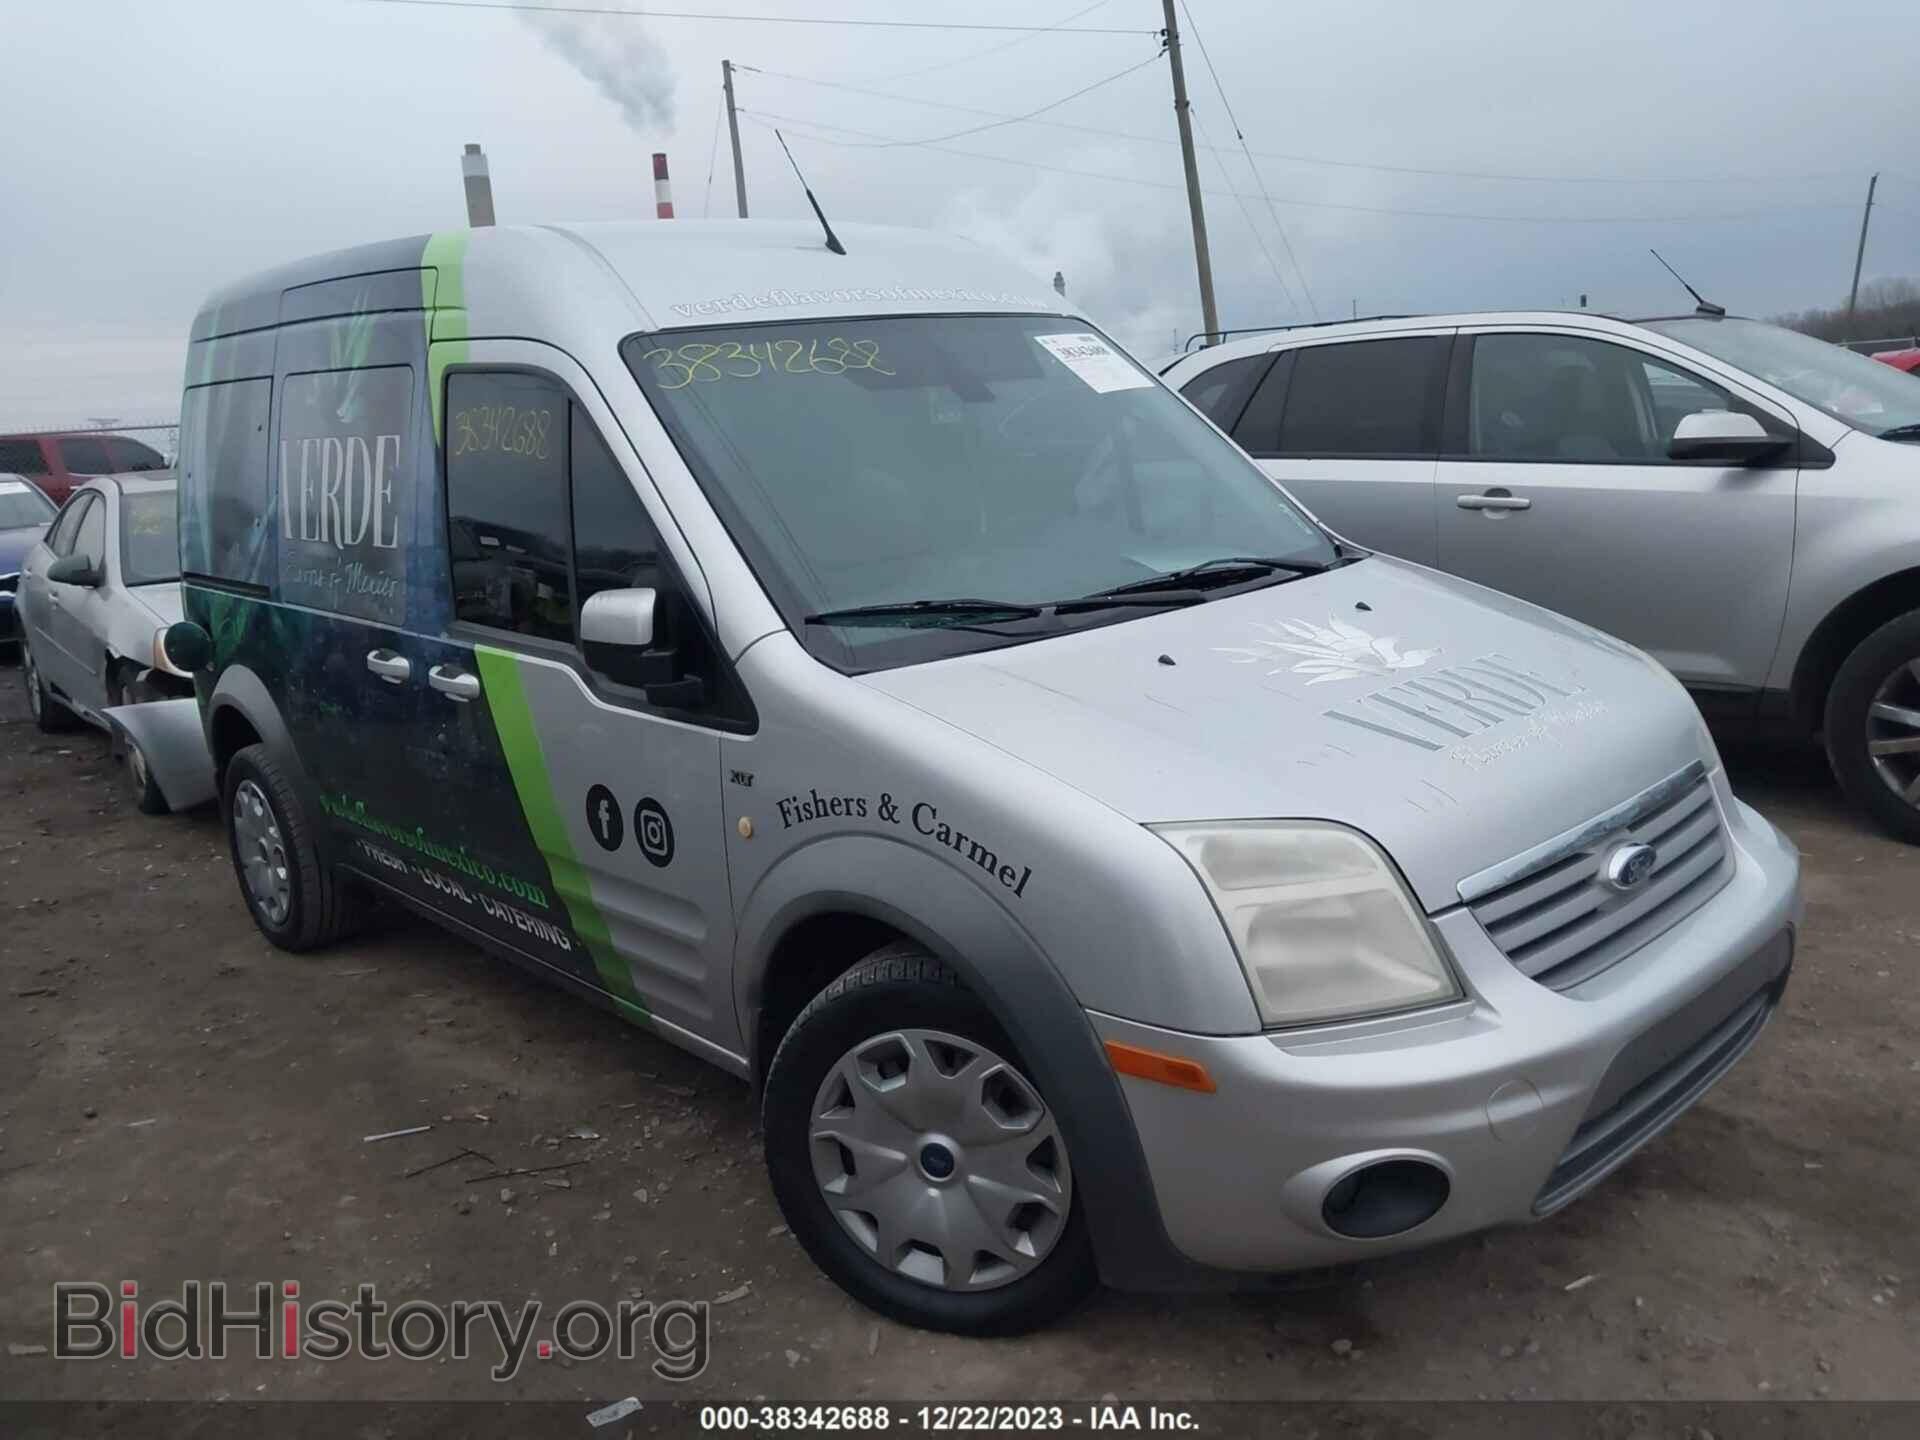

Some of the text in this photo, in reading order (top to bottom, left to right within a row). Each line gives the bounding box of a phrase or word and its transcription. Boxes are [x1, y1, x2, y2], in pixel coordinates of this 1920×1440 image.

[672, 287, 1049, 320] verdeflavorsofmexico.
[281, 434, 401, 550] VERDE
[319, 795, 549, 908] vdflorsofmexico.com
[776, 789, 1032, 898] Fishers & Carmel
[417, 868, 473, 904] LOCAL
[479, 893, 571, 951] CATERING
